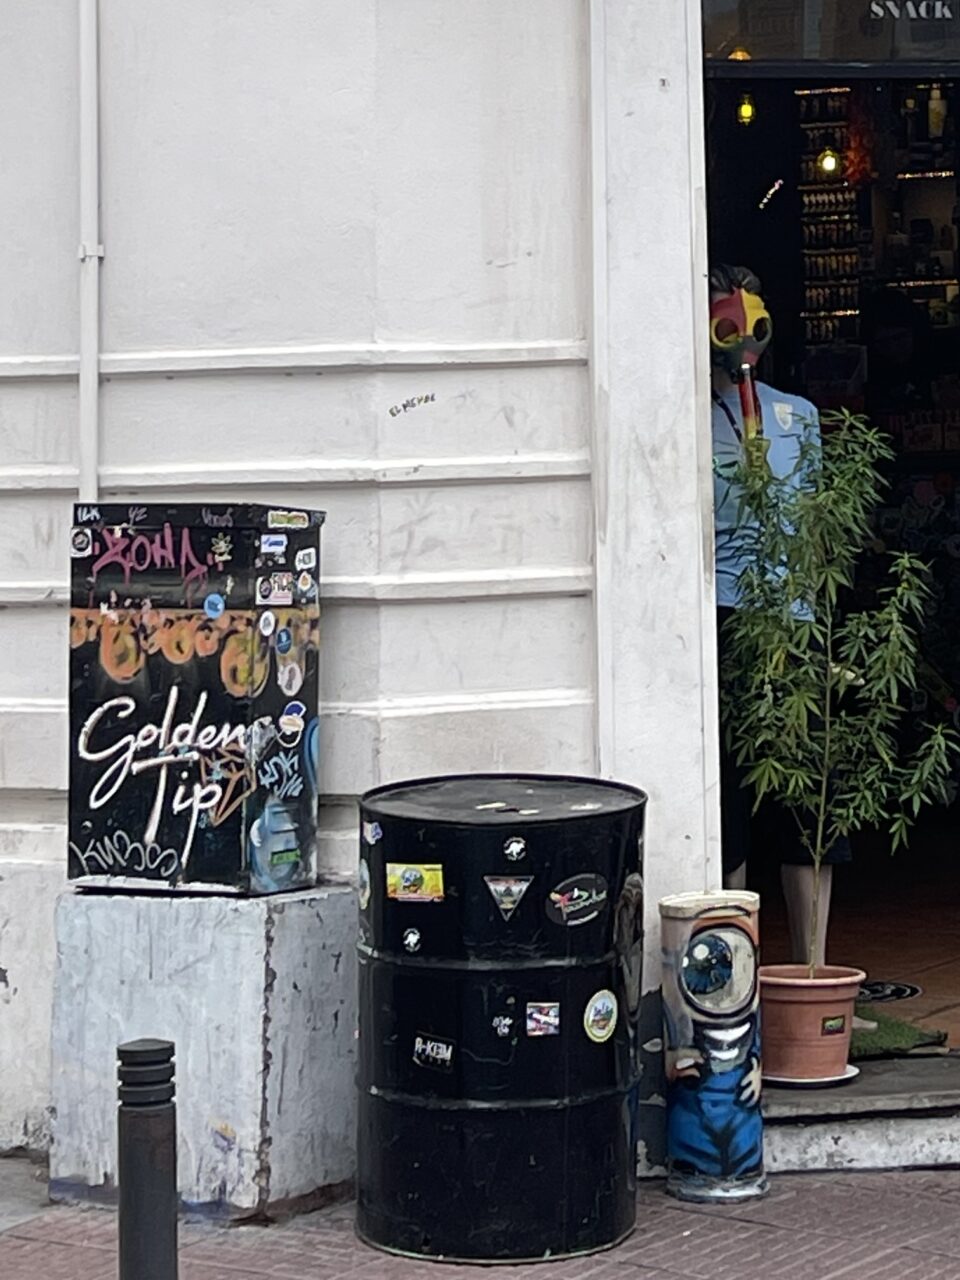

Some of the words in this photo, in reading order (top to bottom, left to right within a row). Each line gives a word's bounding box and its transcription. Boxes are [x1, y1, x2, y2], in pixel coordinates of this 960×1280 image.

[870, 0, 953, 20] SNACK
[79, 686, 248, 810] Golden
[131, 751, 222, 870] Tip
